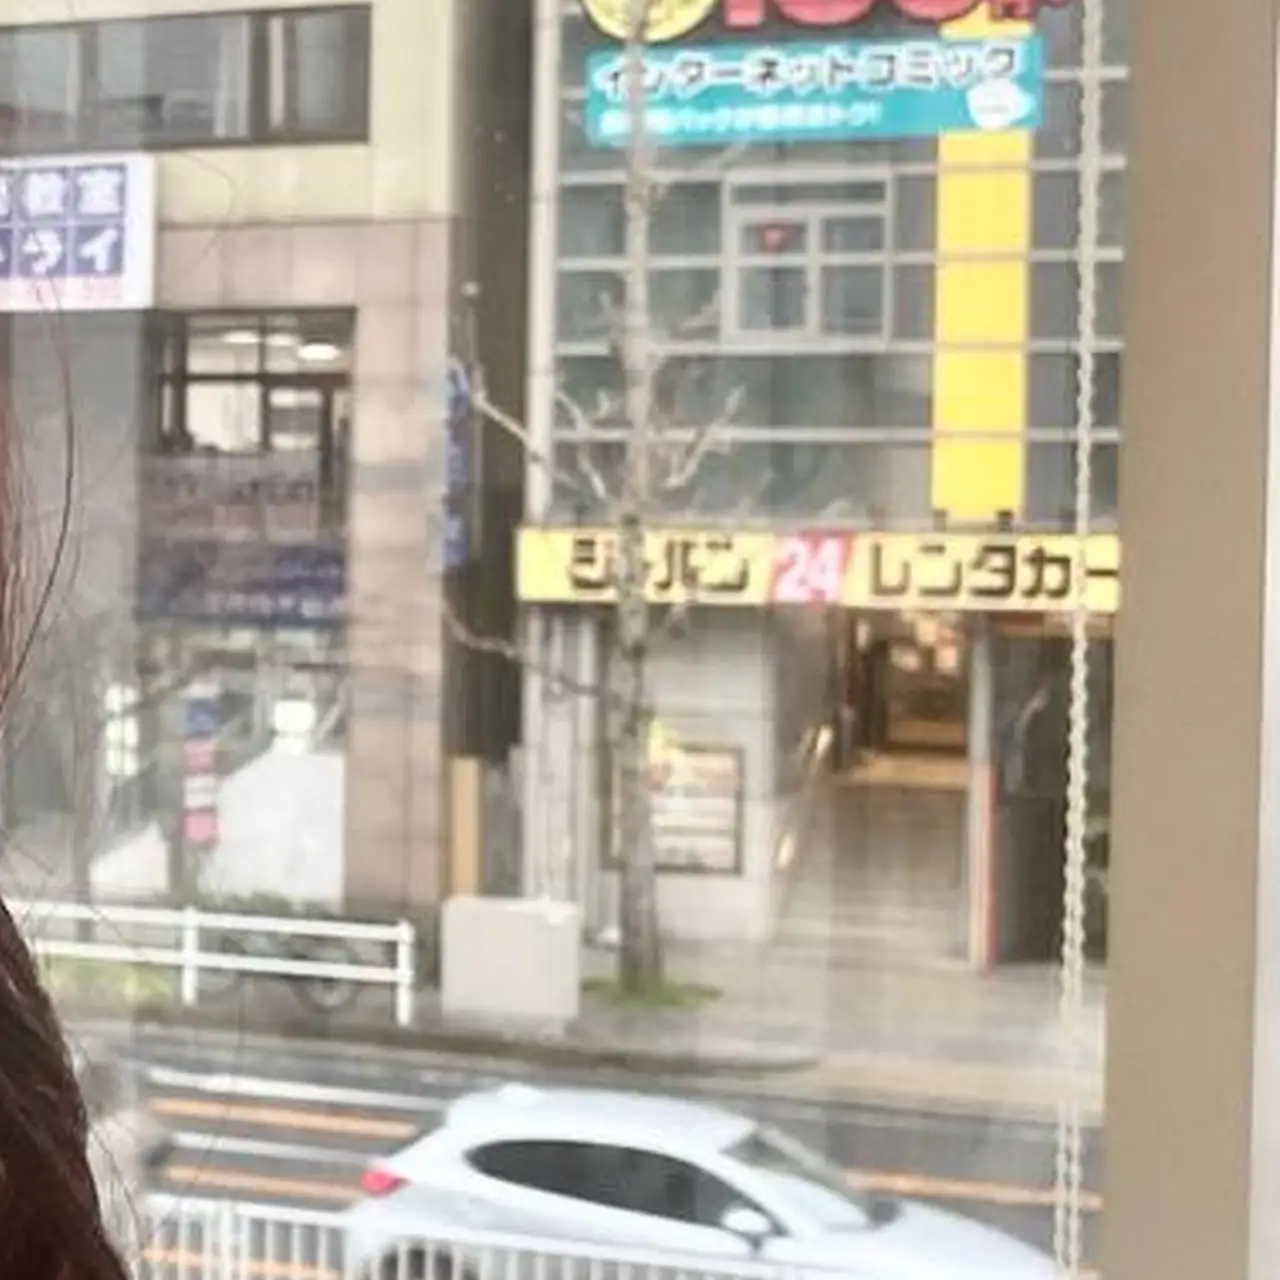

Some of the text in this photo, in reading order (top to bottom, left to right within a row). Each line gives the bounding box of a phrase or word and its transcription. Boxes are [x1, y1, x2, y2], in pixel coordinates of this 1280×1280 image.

[569, 535, 1119, 603] ジパン 24 レンタカー
